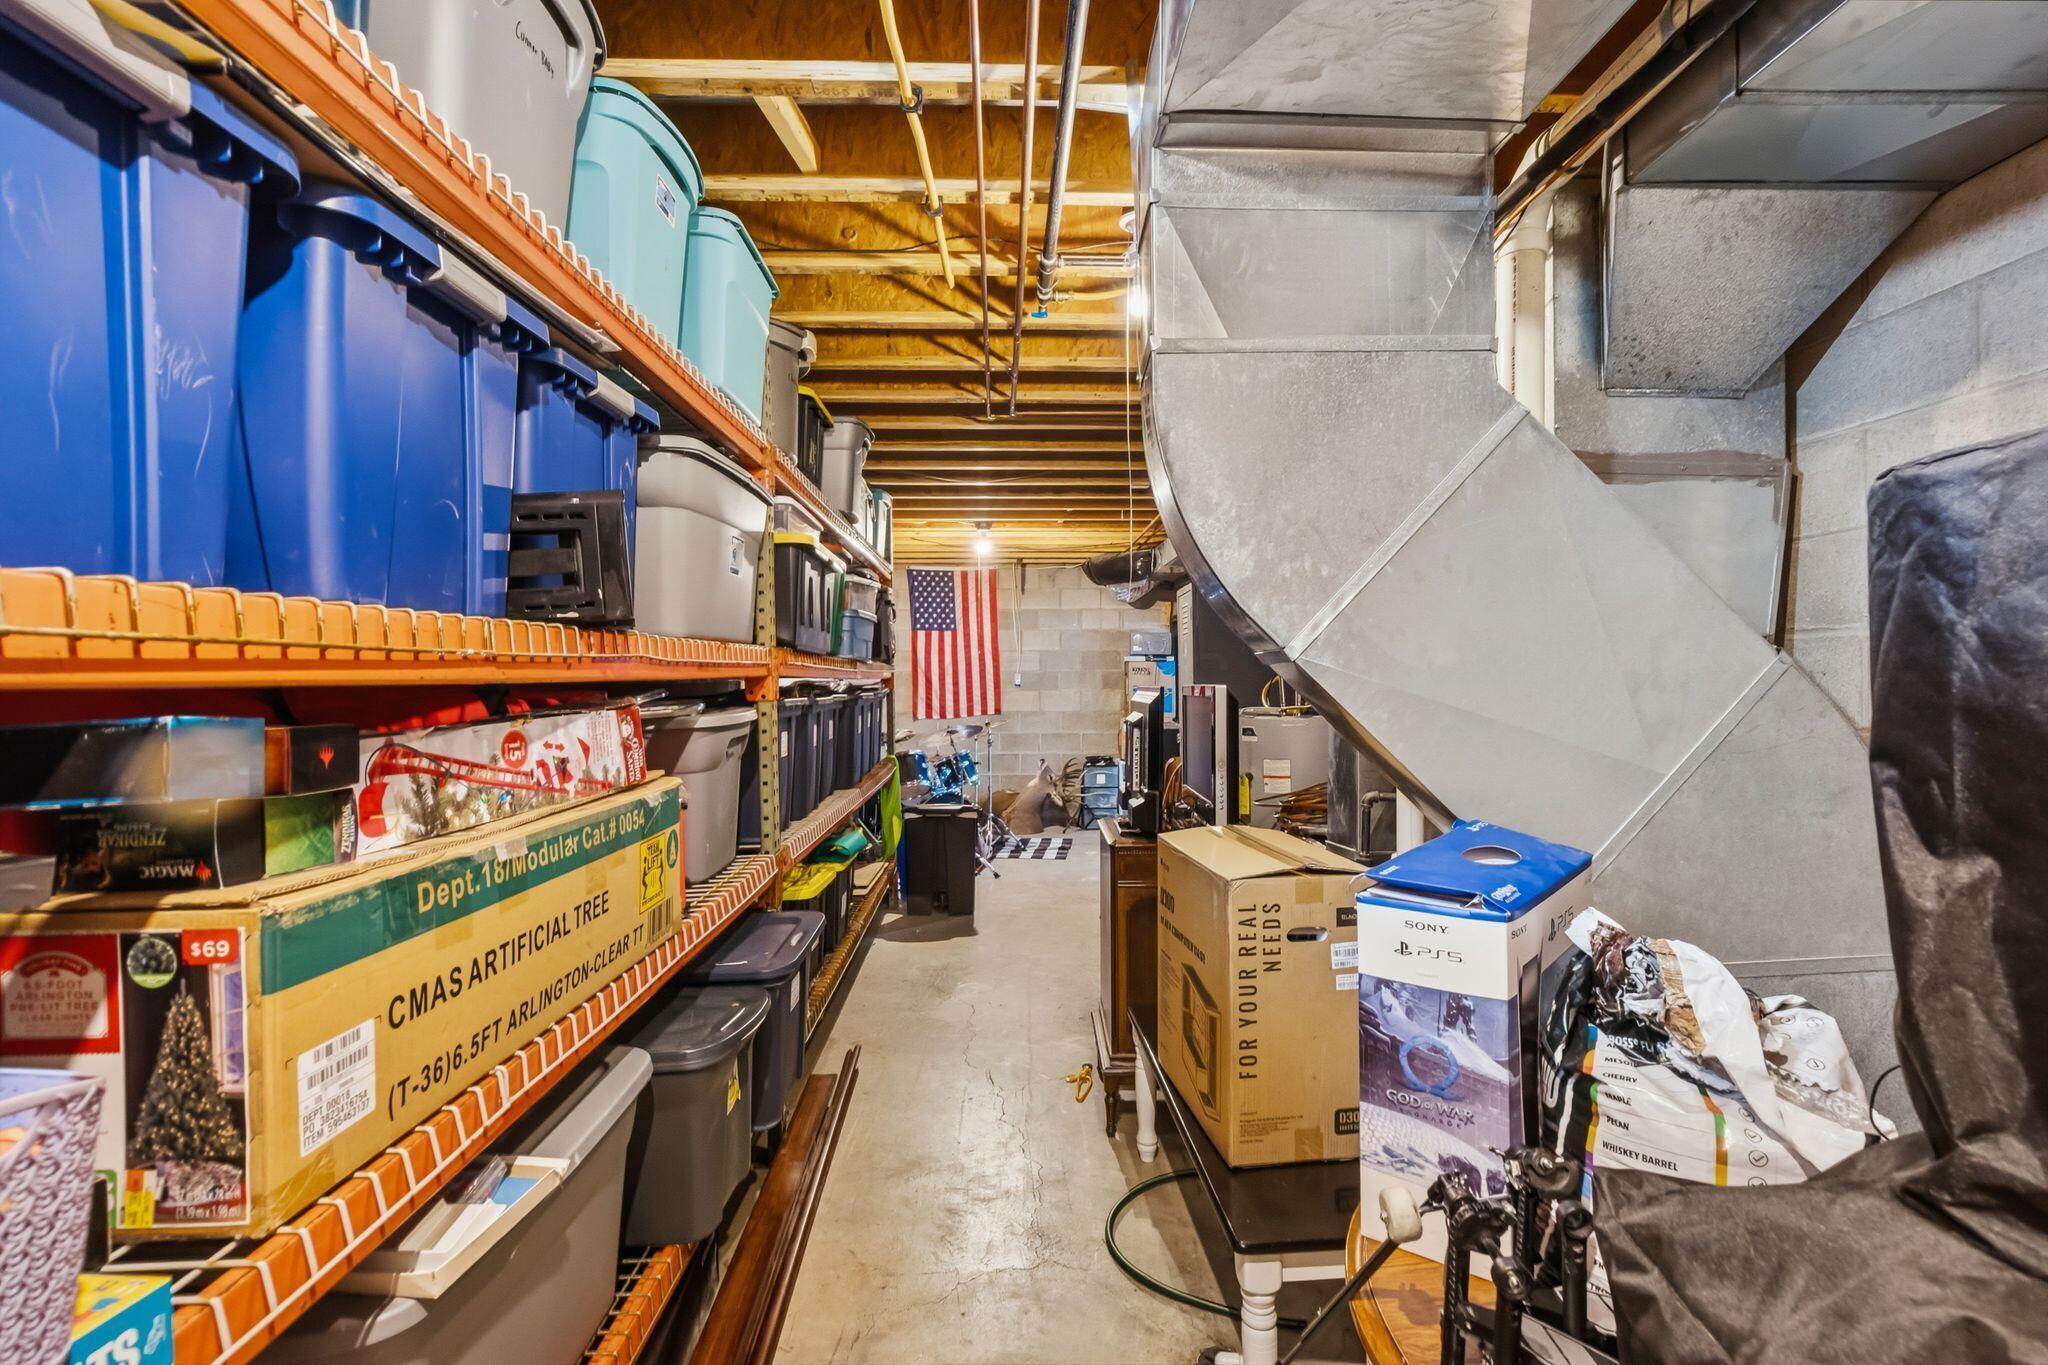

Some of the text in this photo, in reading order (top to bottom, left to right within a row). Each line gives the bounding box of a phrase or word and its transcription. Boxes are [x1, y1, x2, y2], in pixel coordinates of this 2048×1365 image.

[509, 739, 522, 762] 15
[619, 808, 645, 836] 0054
[97, 827, 167, 848] ZENDIKAR
[138, 864, 196, 879] MAGIC
[647, 853, 659, 871] LIFT
[1341, 912, 1358, 921] BLAC
[1557, 905, 1575, 934] PS5
[1404, 920, 1449, 934] SONY
[1511, 923, 1528, 940] SONY
[1262, 903, 1282, 973] NEEDS
[190, 939, 230, 959] $69
[1417, 946, 1463, 963] PS5
[388, 890, 610, 1030] CMAS ARTIFICIAL TREE
[15, 991, 94, 1001] ARLINGTON
[1238, 903, 1258, 1080] FOR YOUR REAL
[388, 923, 644, 1121] (T-36)6.5FT ARLINGTON-CLEAR TT
[1602, 1072, 1638, 1083] CHERRY
[302, 1089, 351, 1126] DEPT 00018
[1386, 1088, 1421, 1109] GOD
[1436, 1102, 1476, 1126] WAR
[1339, 1111, 1360, 1124] D30
[1606, 1115, 1630, 1131] PECAN
[303, 1123, 315, 1137] PO
[303, 1128, 324, 1149] ITEM
[1602, 1140, 1679, 1172] WHISKEY BARREL
